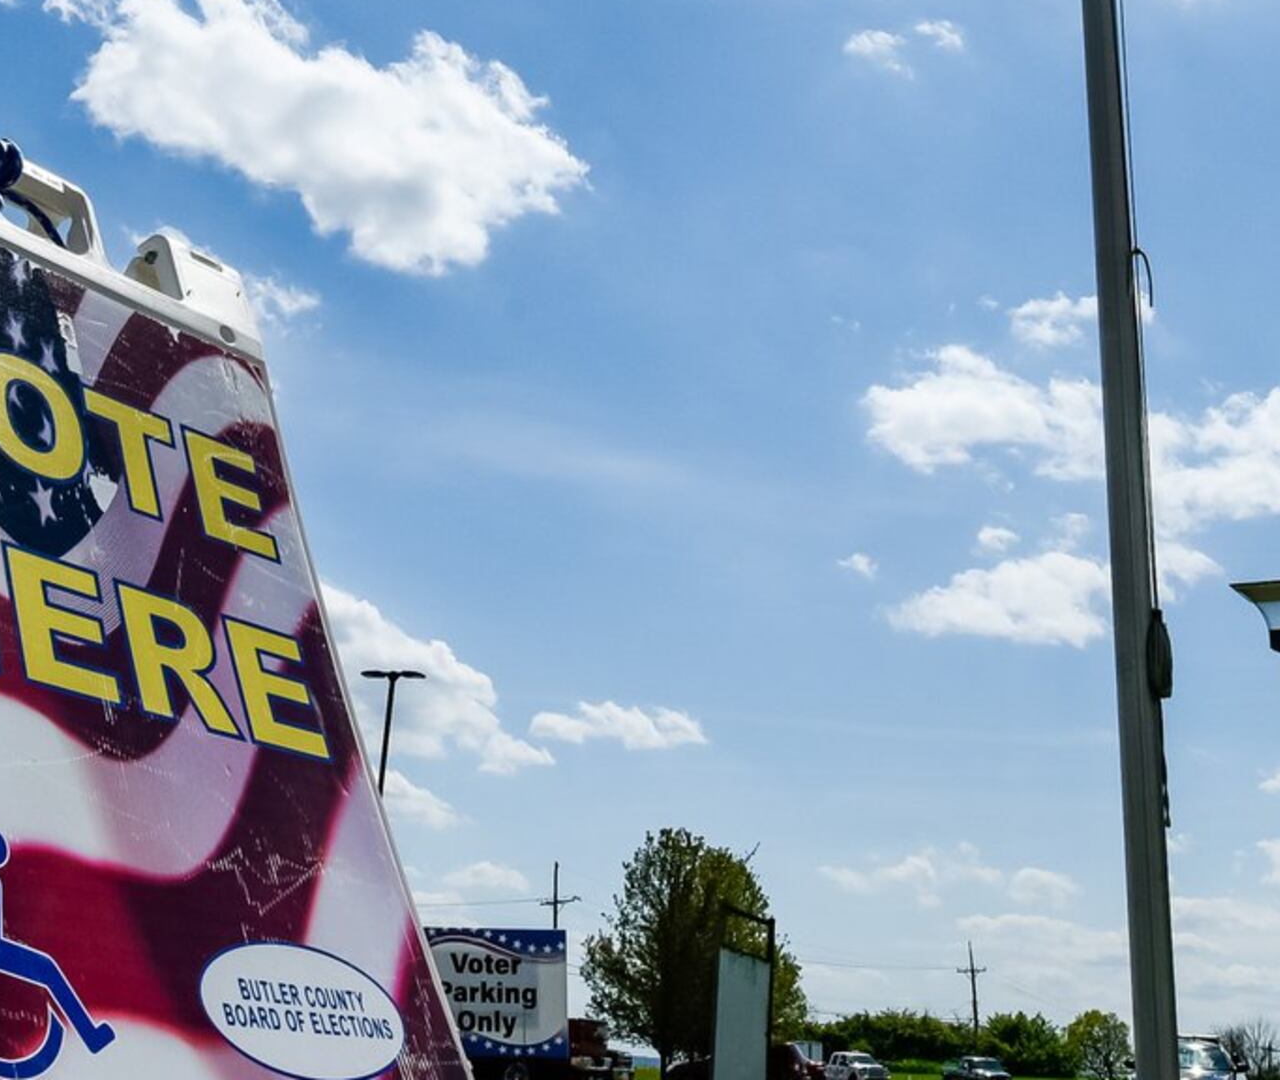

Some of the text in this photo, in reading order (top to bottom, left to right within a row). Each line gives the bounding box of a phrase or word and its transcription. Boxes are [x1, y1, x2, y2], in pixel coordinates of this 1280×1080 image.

[450, 952, 523, 975] Voter
[238, 978, 365, 1012] BUTLER COUNTY
[222, 1003, 394, 1040] BOARD OF ELECTIONS
[457, 1010, 517, 1038] Only
